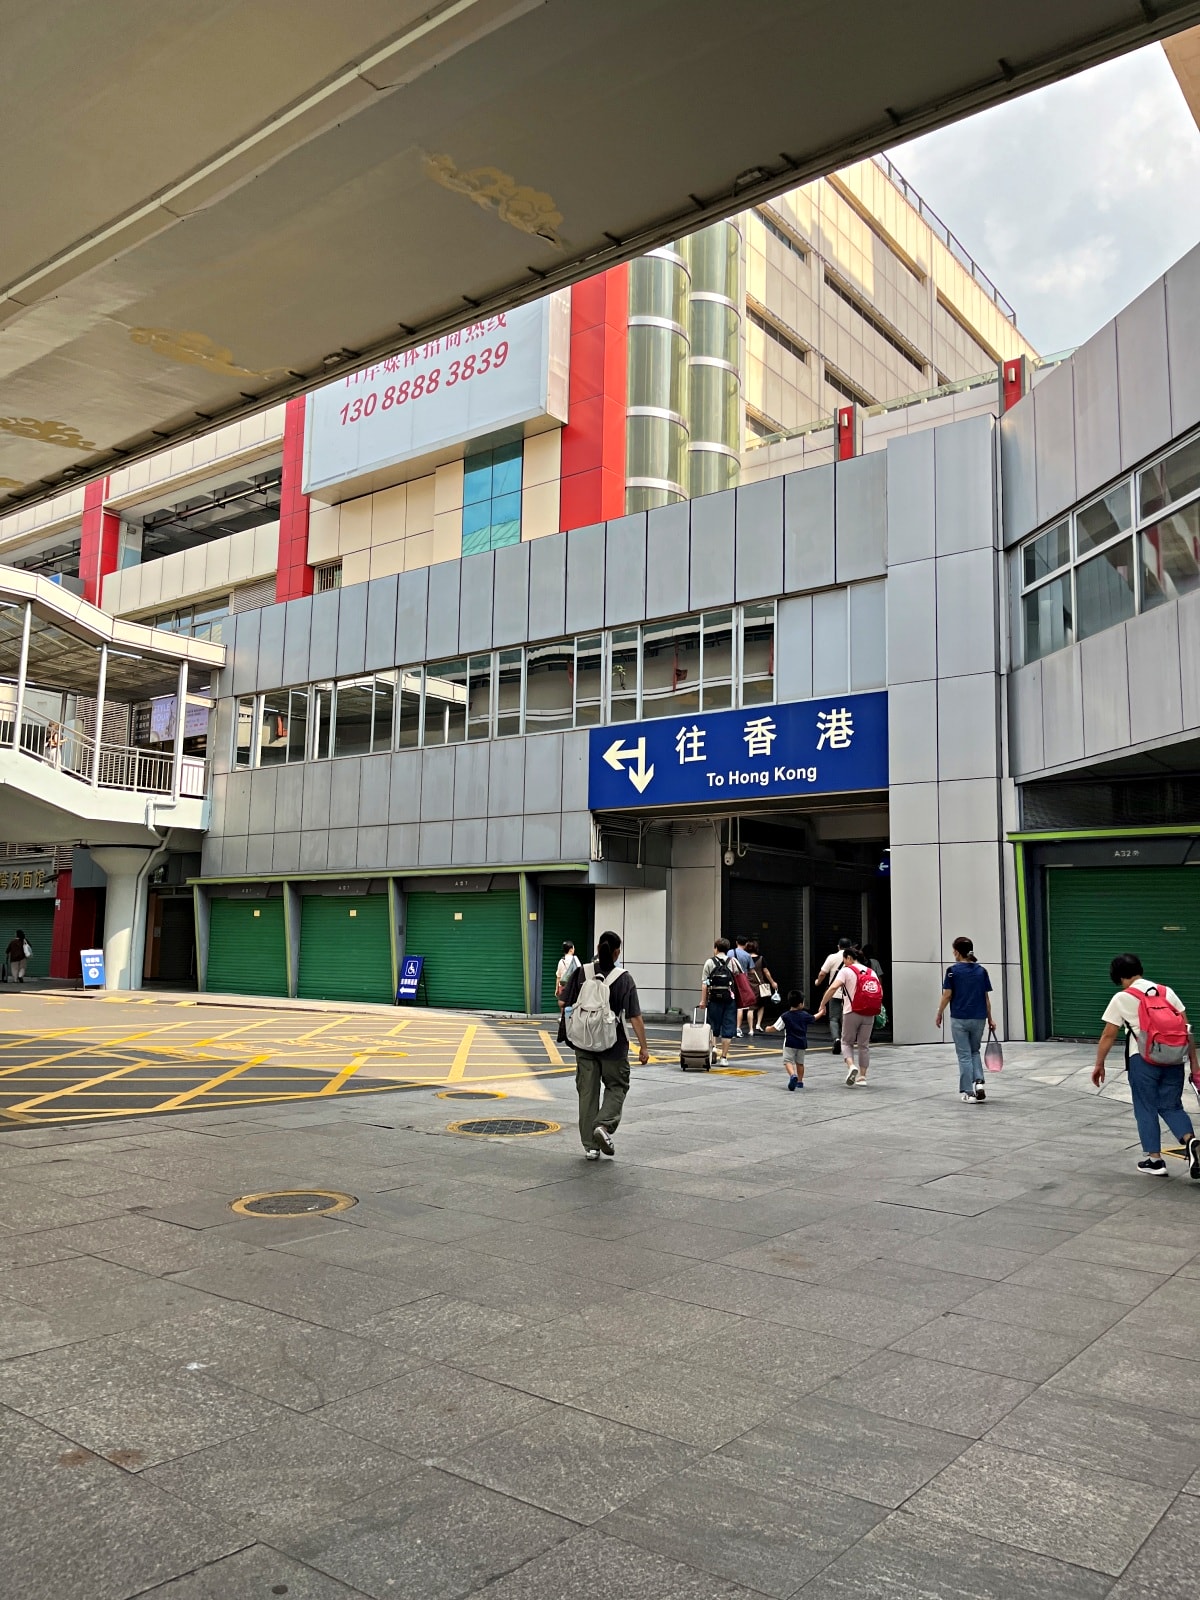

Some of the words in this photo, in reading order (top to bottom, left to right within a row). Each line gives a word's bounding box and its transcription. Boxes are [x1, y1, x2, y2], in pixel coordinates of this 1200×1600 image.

[339, 392, 378, 426] 130
[381, 368, 441, 411] 8888
[445, 341, 510, 387] 3839
[675, 708, 855, 765] 往香港
[706, 772, 725, 787] To
[728, 770, 770, 787] Hong
[774, 766, 818, 783] Kong
